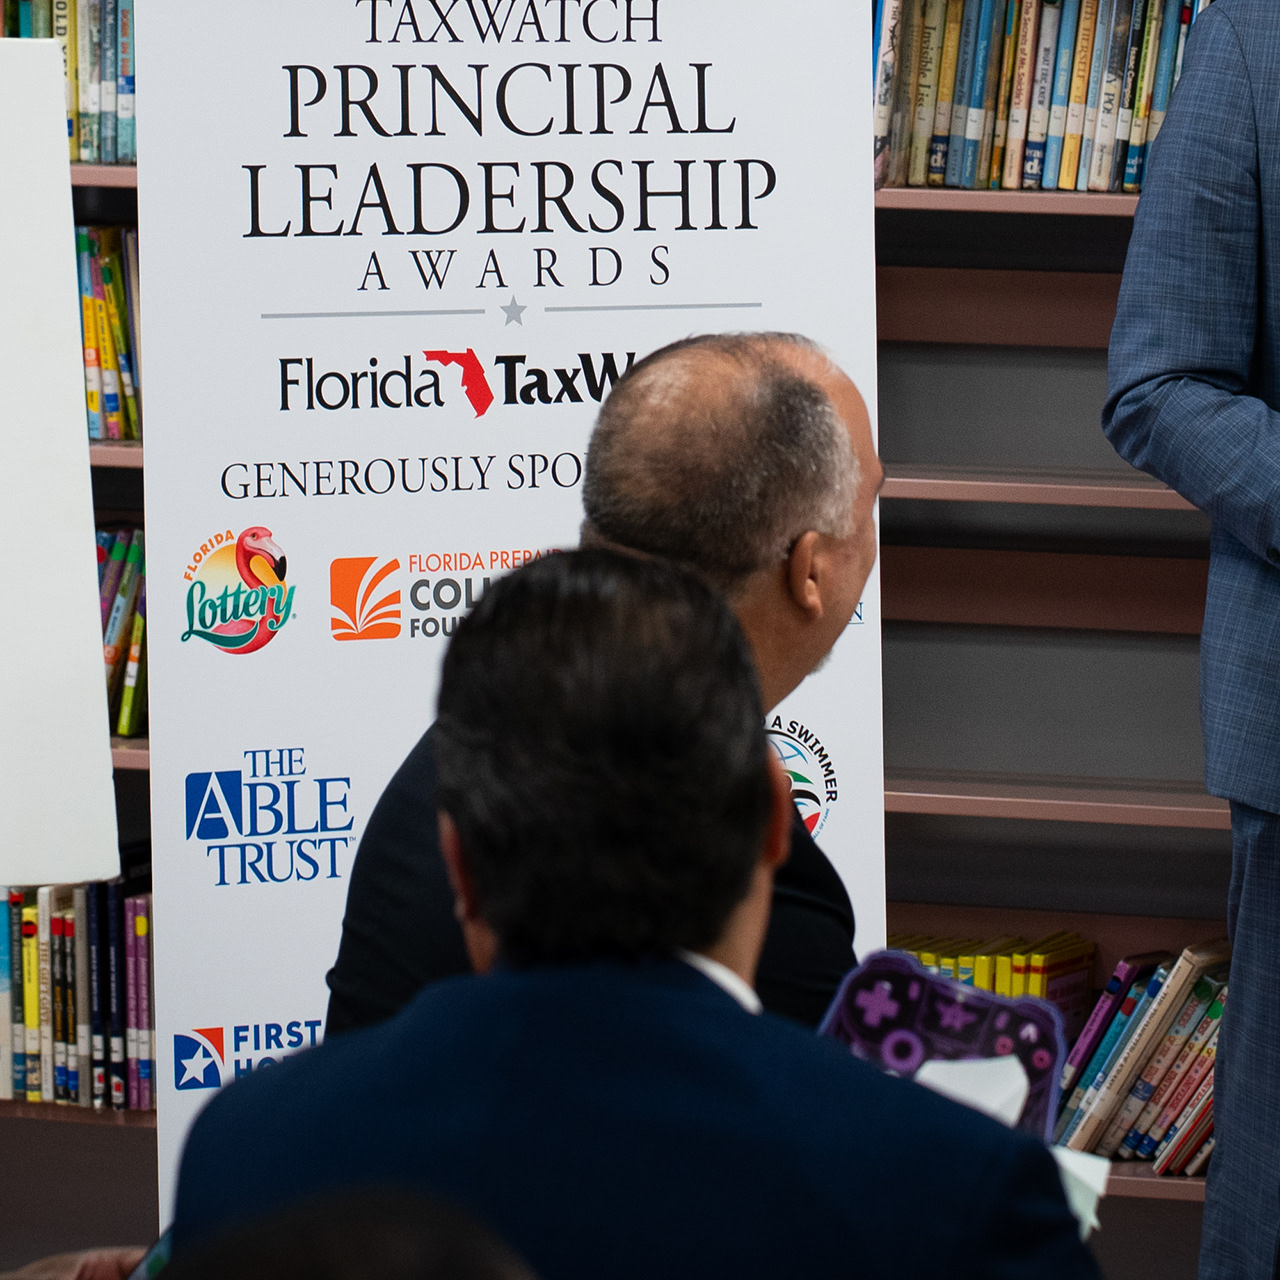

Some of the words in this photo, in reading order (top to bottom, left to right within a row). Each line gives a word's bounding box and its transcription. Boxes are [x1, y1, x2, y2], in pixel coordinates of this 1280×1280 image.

[56, 0, 67, 36] OLD
[1024, 0, 1033, 15] The
[1020, 17, 1031, 46] Secrets
[919, 25, 937, 79] Invisible
[1041, 46, 1051, 66] WHAT
[1076, 26, 1091, 81] HERSELF
[1127, 46, 1139, 69] Isaac
[1040, 68, 1050, 85] ERIC
[1122, 70, 1136, 108] Campion
[281, 62, 737, 139] PRINCIPAL
[917, 83, 932, 107] Liss
[1037, 86, 1048, 106] KNEW
[242, 158, 777, 239] LEADERSHIP
[357, 245, 671, 292] AWARDS
[279, 354, 445, 411] Florida
[494, 351, 637, 405] TaxW
[221, 455, 496, 500] GENEROUSLY
[183, 529, 236, 583] FLORIDA
[409, 553, 486, 573] FLORIDA
[180, 581, 297, 648] Lottery
[244, 748, 307, 778] THE
[771, 715, 783, 730] A
[786, 720, 838, 803] SWIMMER
[186, 770, 355, 841] ABLE
[822, 808, 830, 823] FAME
[207, 838, 349, 886] TRUST
[40, 941, 49, 964] THE
[40, 967, 49, 1023] GIFT-GIVE
[233, 1020, 322, 1052] FIRST
[1187, 1041, 1195, 1052] OF
[1206, 1047, 1214, 1058] OF
[1179, 1051, 1189, 1063] THE
[1197, 1055, 1208, 1067] THE
[1150, 1070, 1179, 1105] UNIVERSE
[1169, 1074, 1196, 1111] UNIVERSE
